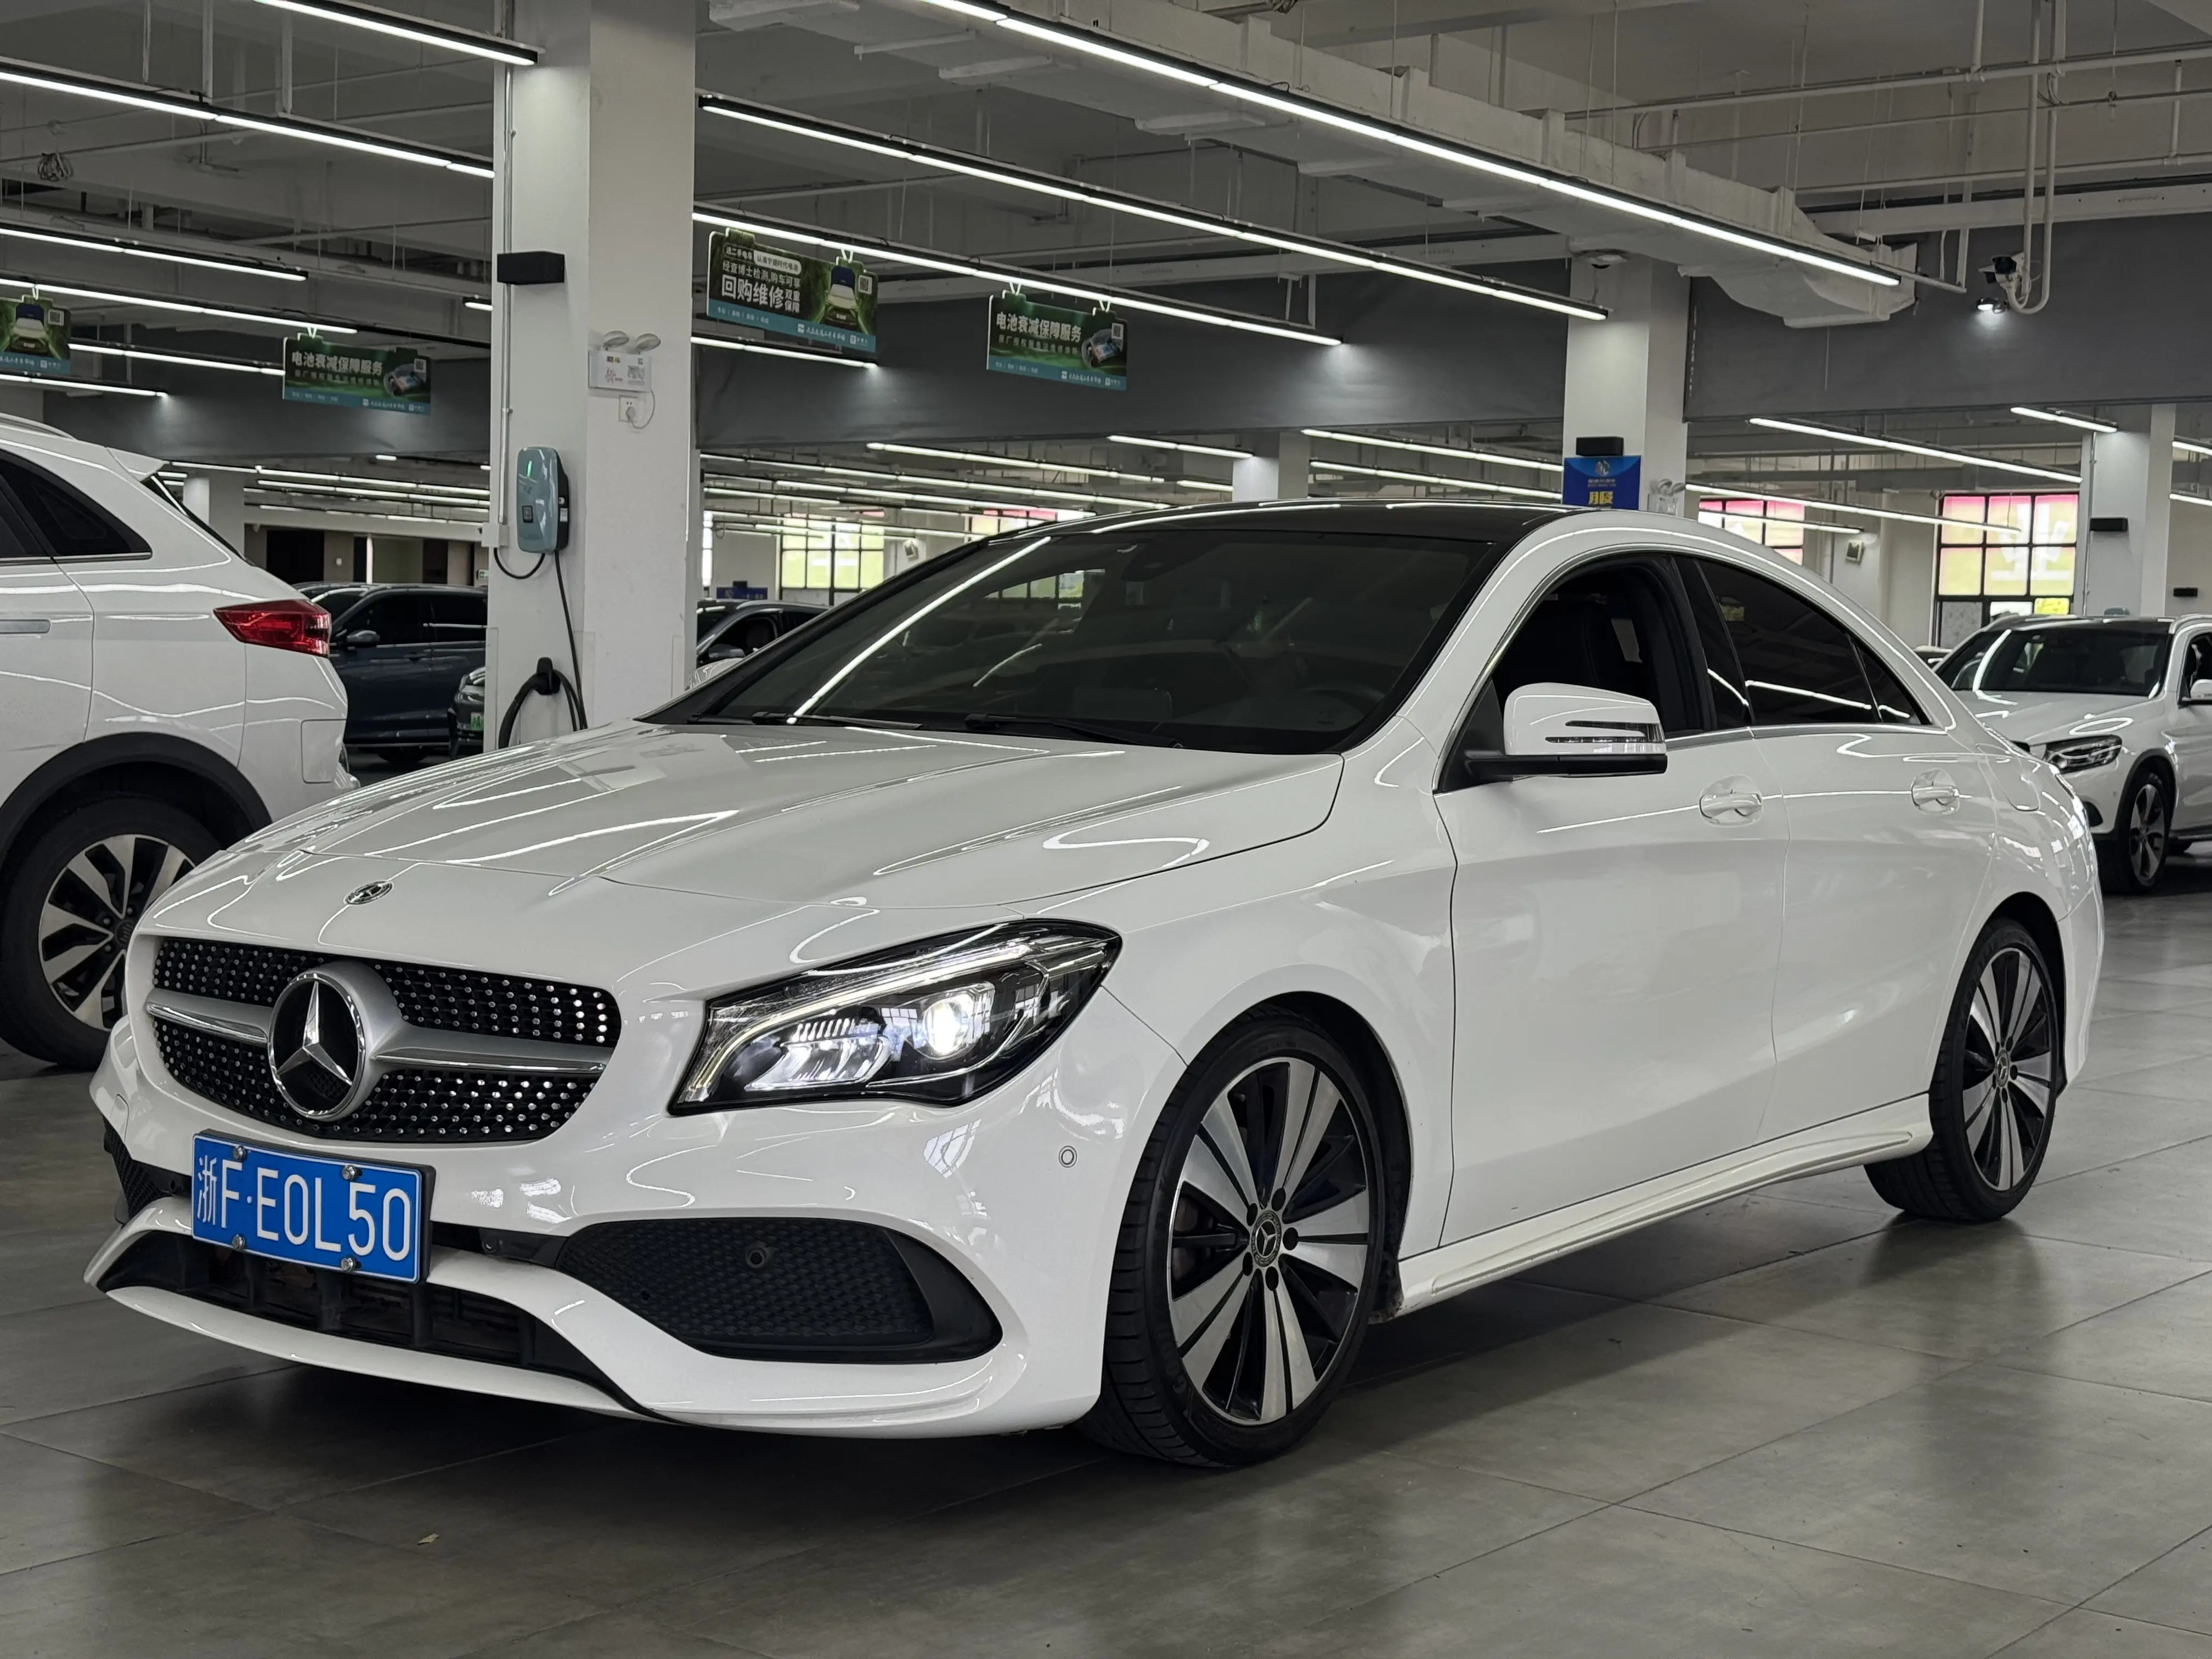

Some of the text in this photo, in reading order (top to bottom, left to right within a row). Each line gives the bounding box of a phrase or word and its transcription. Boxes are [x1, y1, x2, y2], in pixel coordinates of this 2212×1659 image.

[721, 274, 784, 309] 回购维修
[996, 312, 1081, 343] 电池衰减保障服务
[292, 351, 382, 376] 电池衰减保障服务
